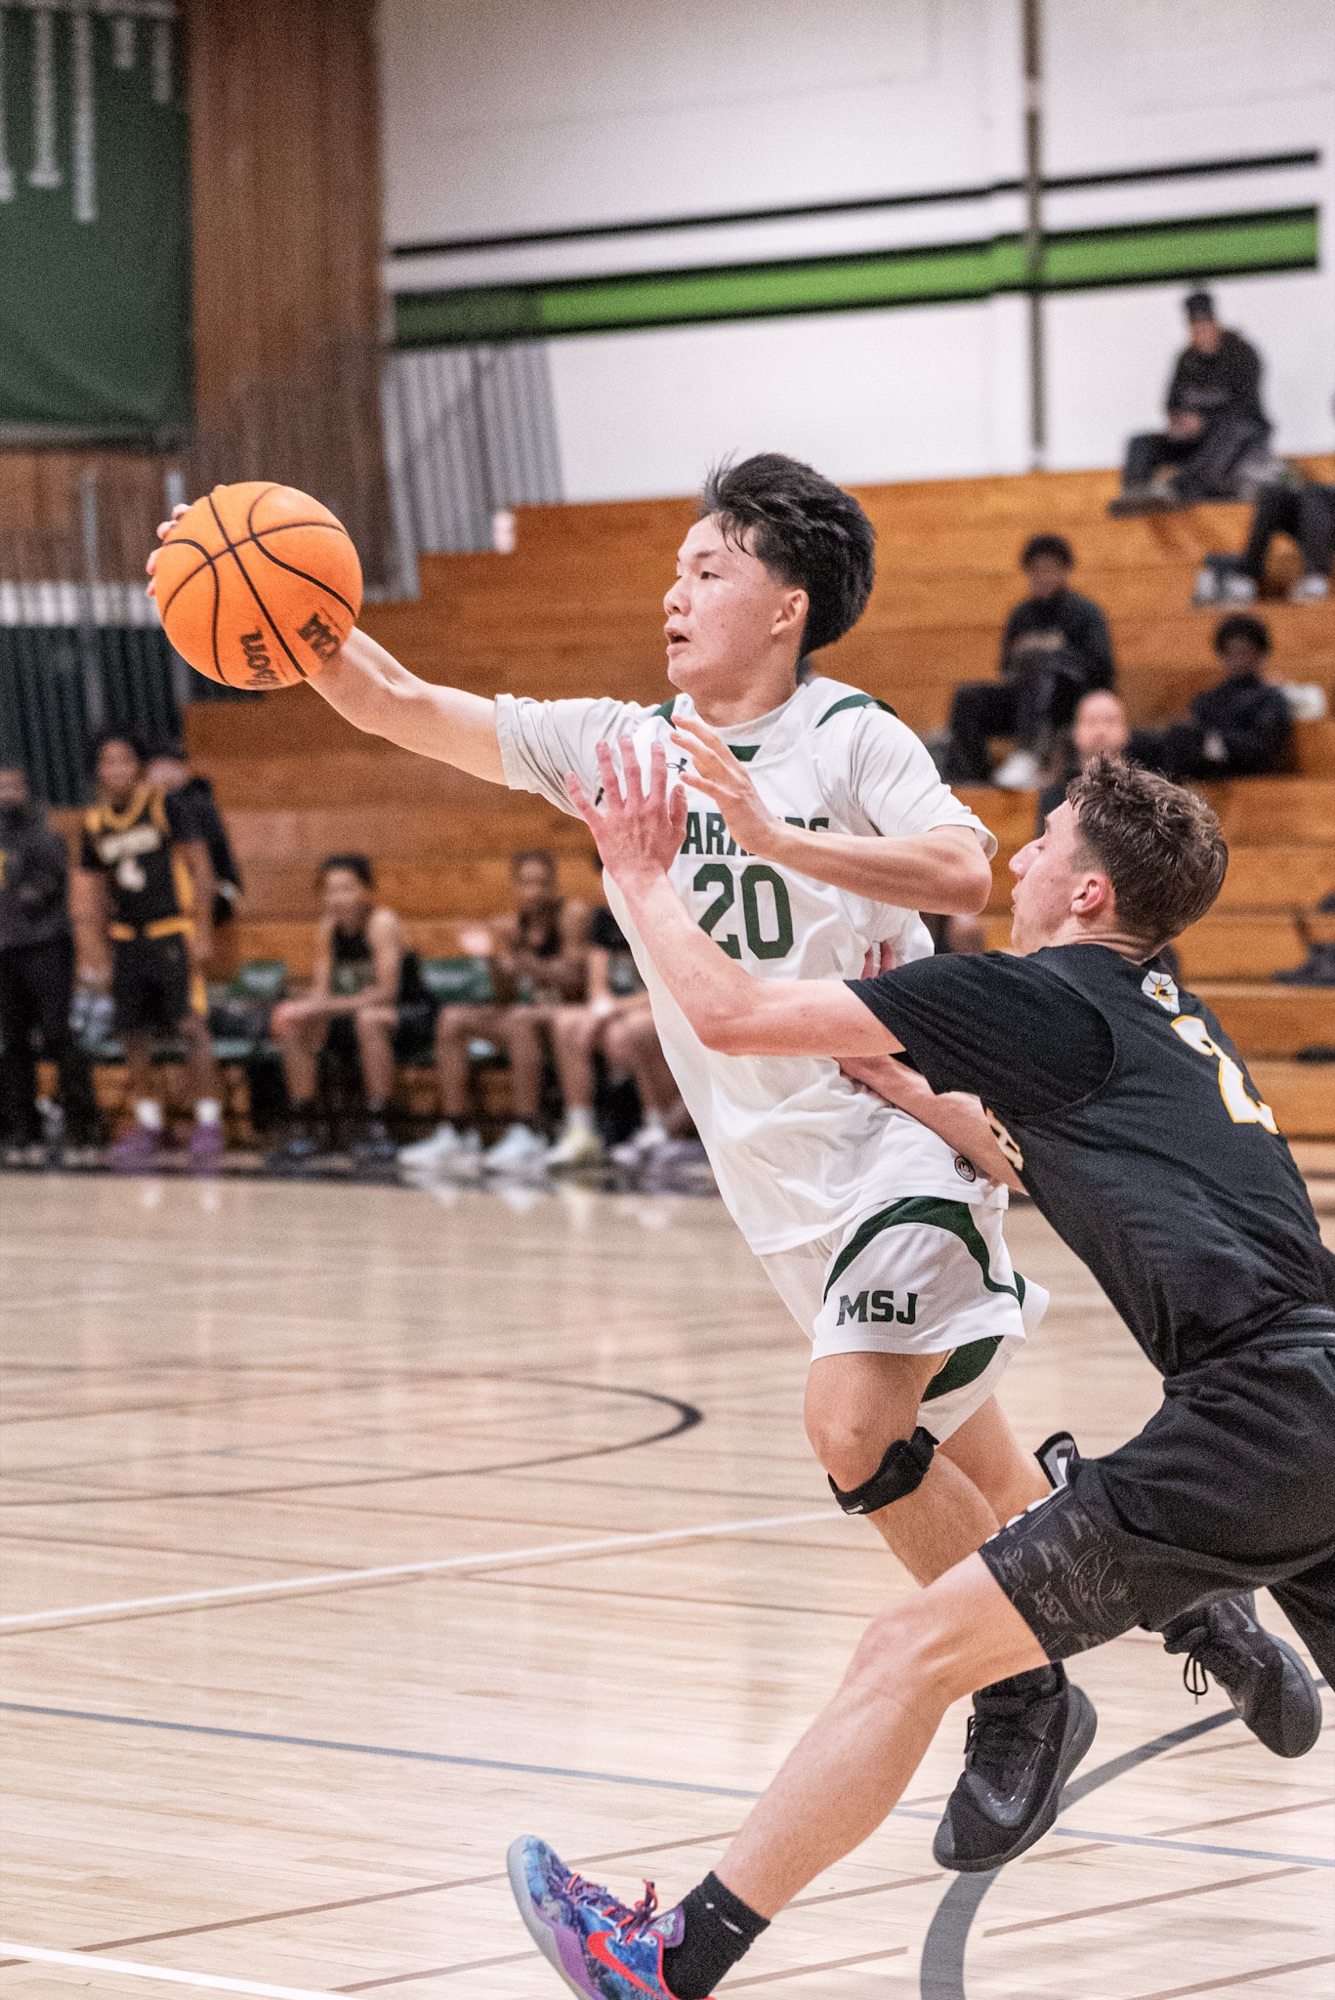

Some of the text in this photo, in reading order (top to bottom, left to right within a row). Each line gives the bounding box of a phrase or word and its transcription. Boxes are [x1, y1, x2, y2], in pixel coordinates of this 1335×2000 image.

[240, 627, 284, 687] lson
[693, 863, 795, 960] 20
[836, 1290, 918, 1326] MSJ
